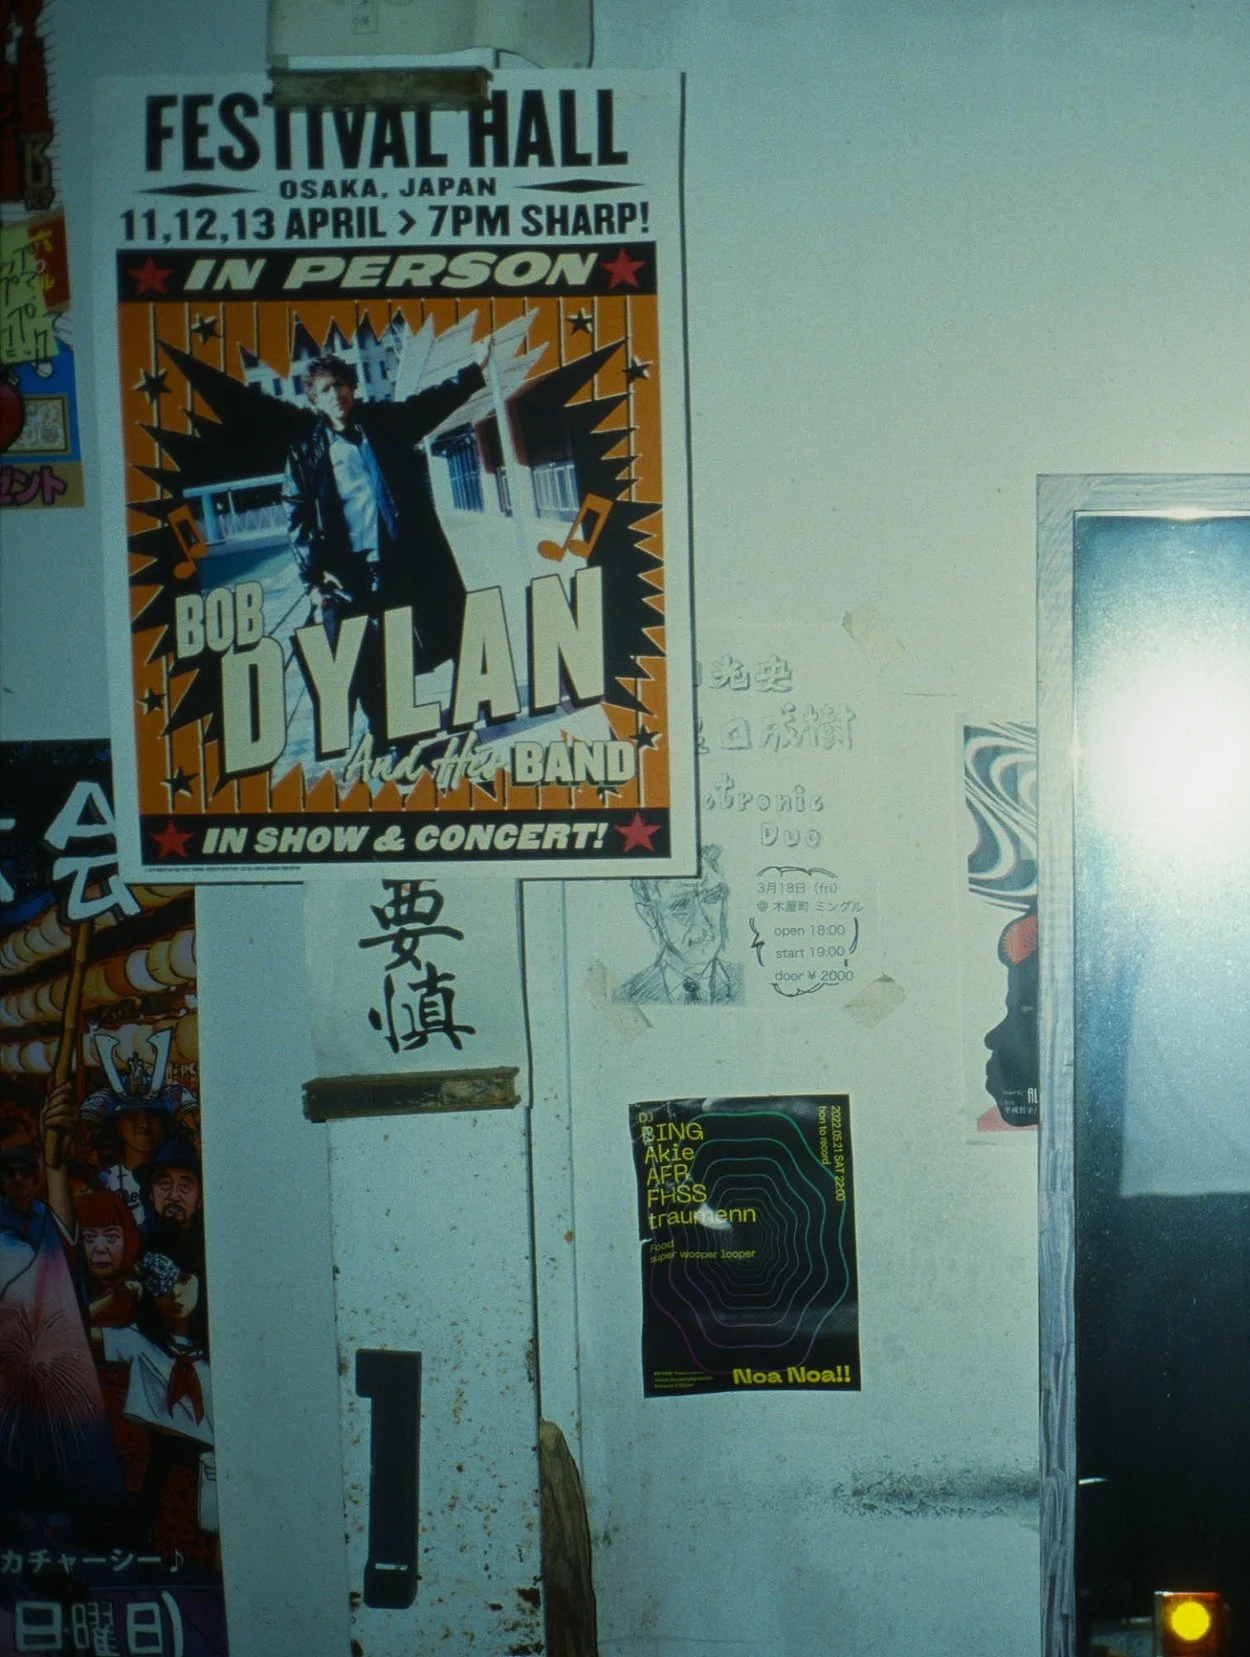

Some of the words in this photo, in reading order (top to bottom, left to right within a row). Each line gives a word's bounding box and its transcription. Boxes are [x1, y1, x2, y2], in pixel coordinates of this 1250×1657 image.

[144, 91, 450, 172] FESTIVAL
[471, 88, 630, 170] HALL
[279, 179, 388, 200] OSAKA,
[400, 177, 497, 198] JAPAN
[120, 209, 275, 245] 11,12,13
[285, 206, 388, 241] APRIL
[429, 205, 511, 238] 7PM
[521, 201, 651, 236] SHARP!
[183, 258, 264, 291] IN
[283, 250, 600, 290] PERSON
[175, 581, 265, 659] BOB
[220, 566, 605, 775] DYLAN
[514, 741, 638, 787] BAND
[202, 827, 252, 855] IN
[255, 824, 367, 854] SHOW
[373, 824, 406, 853] &
[412, 821, 609, 852] CONCERT!
[759, 823, 822, 850] Duo
[815, 901, 865, 912] ミングル
[773, 927, 805, 938] open
[810, 924, 845, 936] 18:00
[775, 947, 805, 959] start
[811, 945, 845, 957] 19:00
[774, 970, 804, 981] door
[820, 970, 855, 981] 2000
[638, 1112, 653, 1123] DJ
[641, 1122, 704, 1144] BING
[645, 1143, 695, 1165] Akie
[833, 1155, 845, 1174] SAT
[647, 1183, 708, 1209] FHSS
[720, 1249, 757, 1260] looper
[732, 1368, 784, 1385] Noa
[787, 1365, 852, 1384] Noa!!
